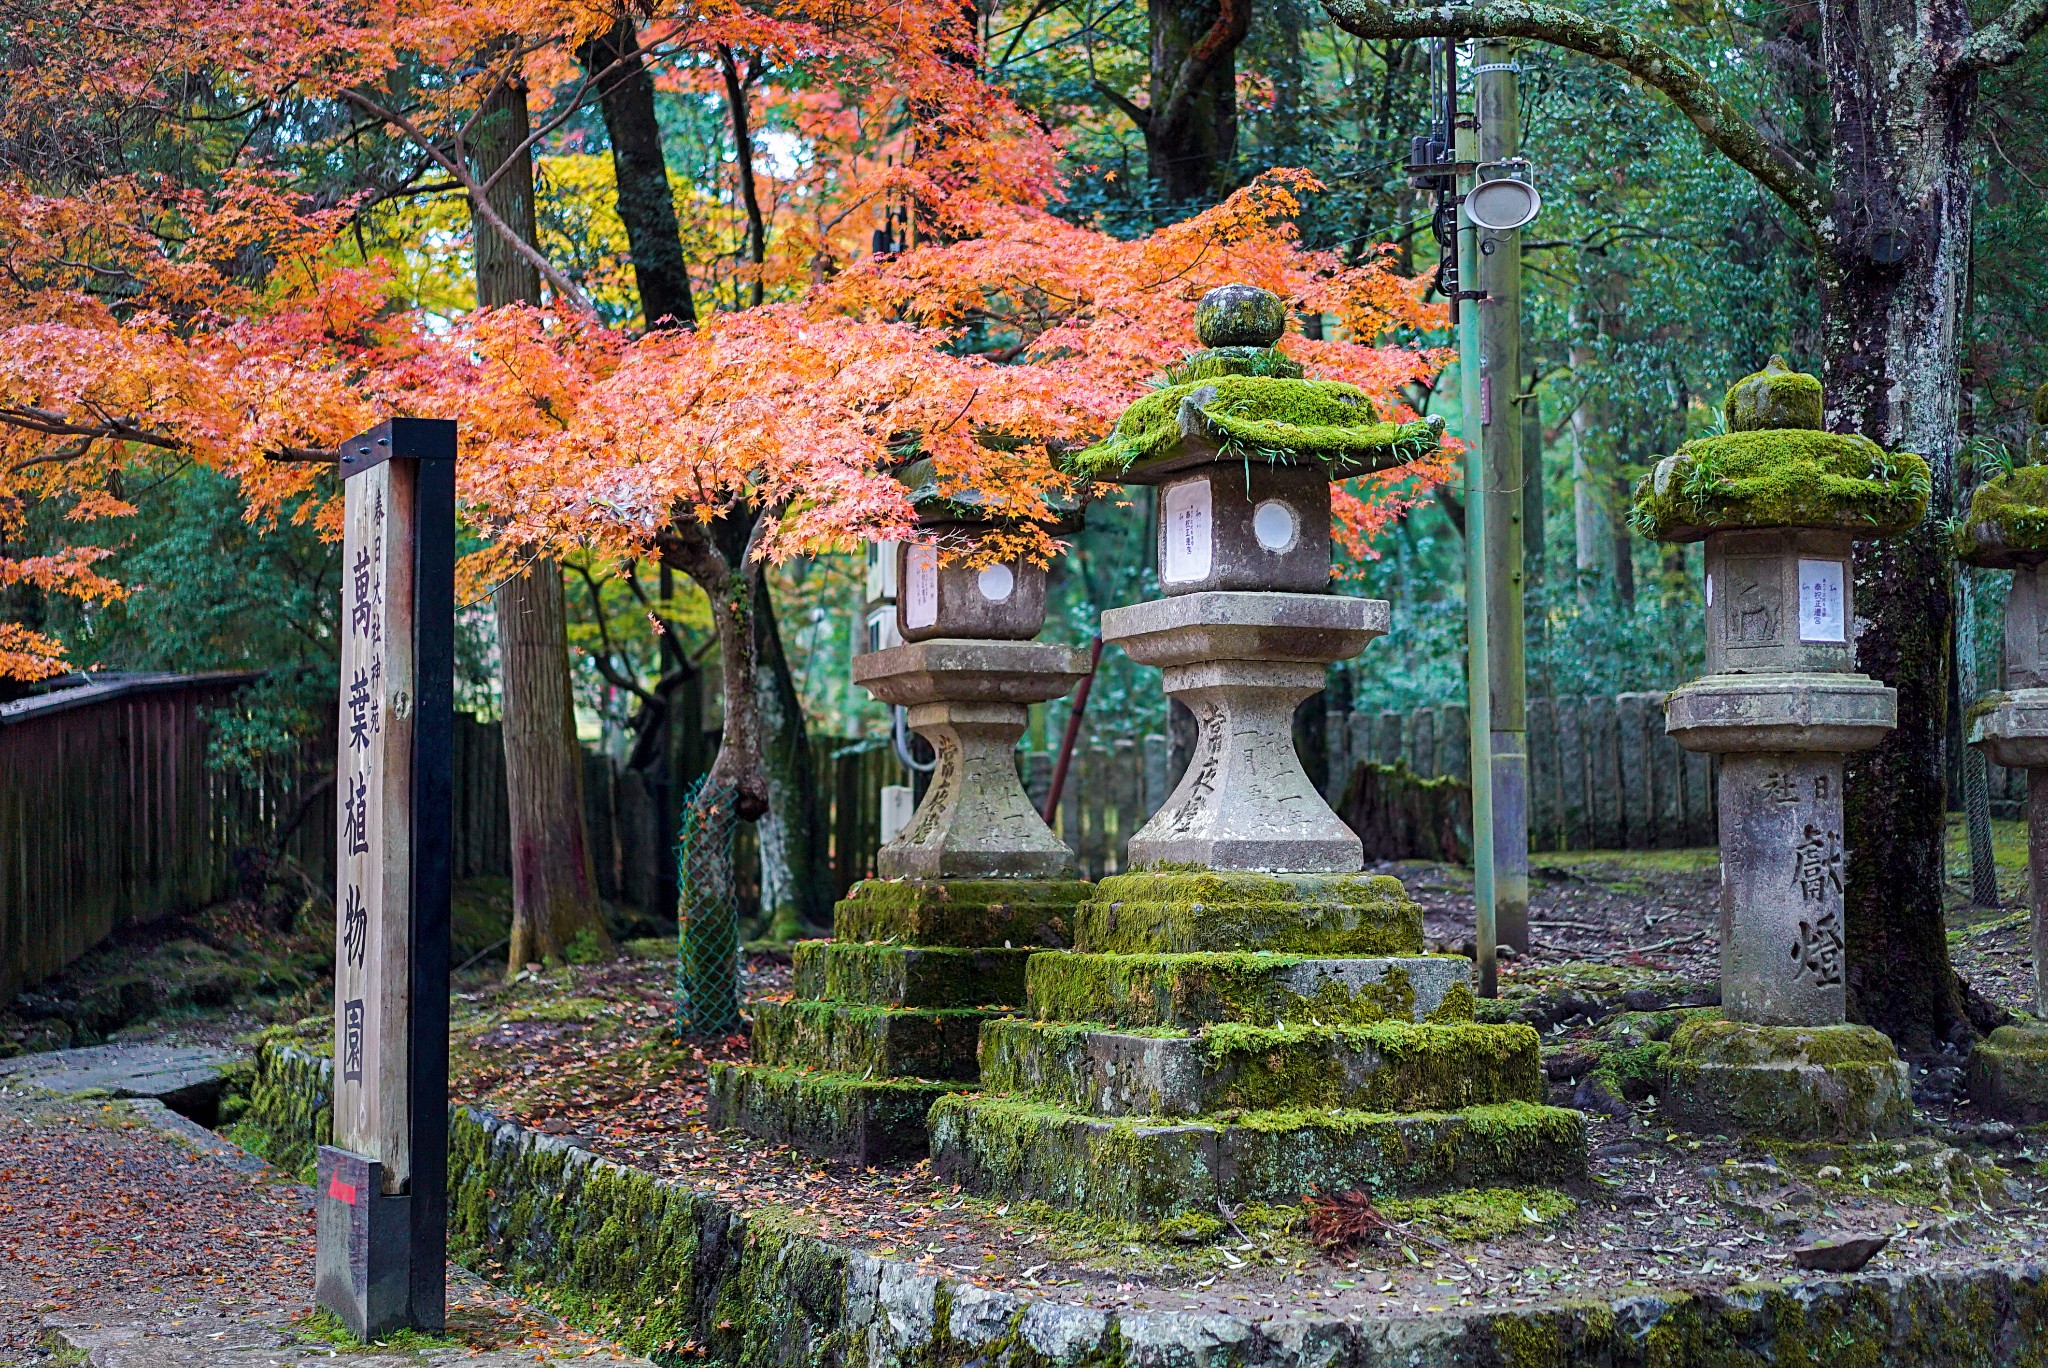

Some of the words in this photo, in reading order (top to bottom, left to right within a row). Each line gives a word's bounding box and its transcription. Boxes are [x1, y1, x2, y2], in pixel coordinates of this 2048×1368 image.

[368, 488, 386, 734] 春日大社神苑
[343, 545, 373, 1089] 萬葉植物園
